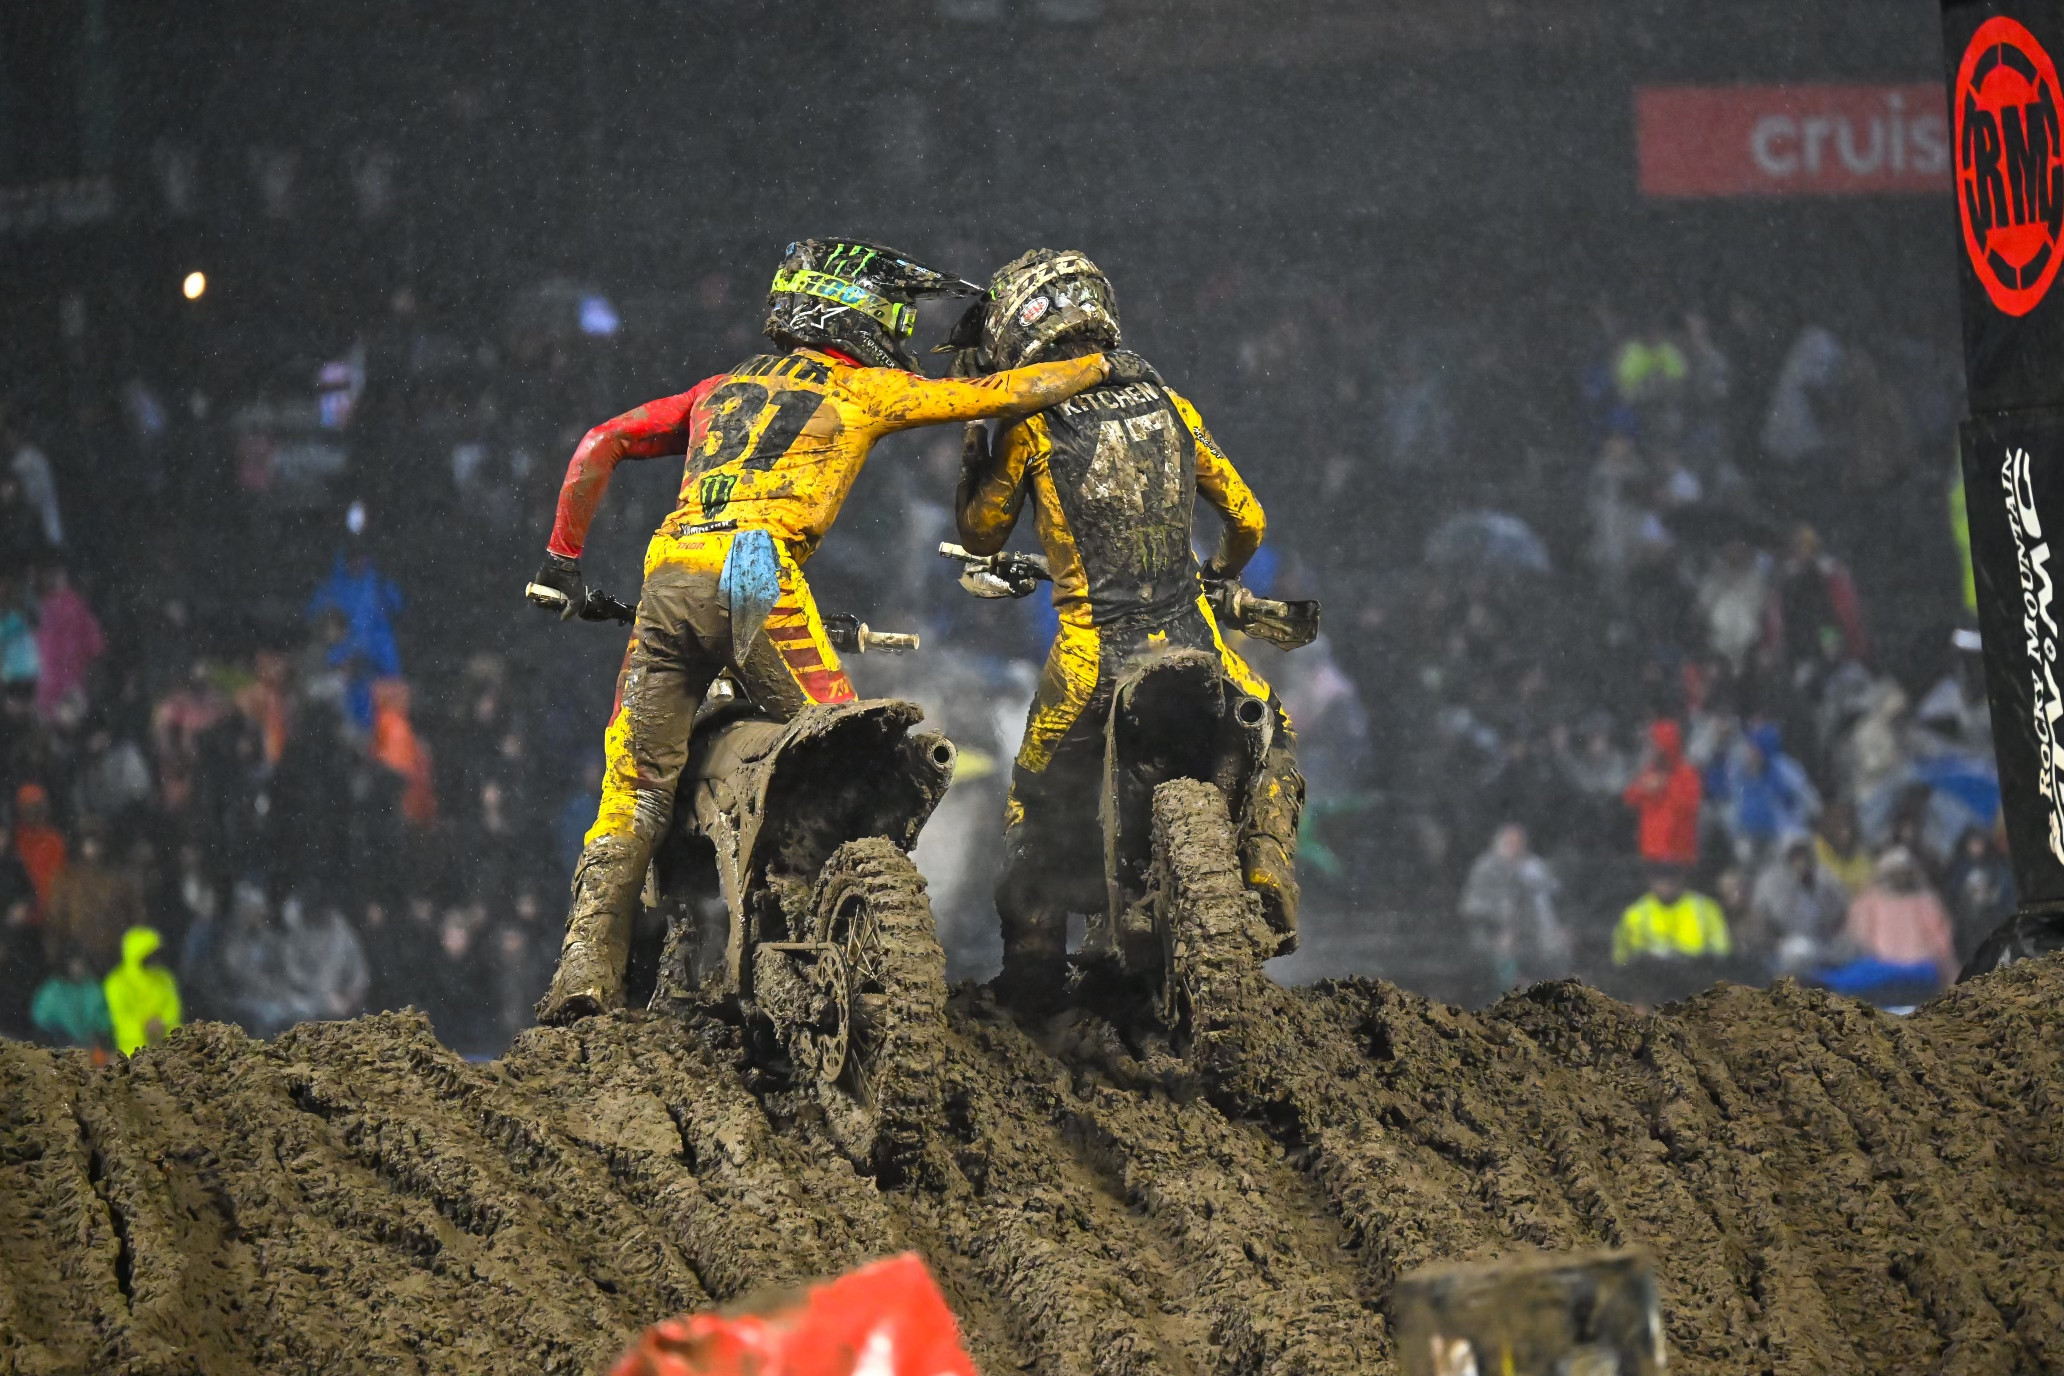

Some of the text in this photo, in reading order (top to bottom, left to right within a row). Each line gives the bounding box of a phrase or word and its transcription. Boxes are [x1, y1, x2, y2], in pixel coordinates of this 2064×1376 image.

[686, 382, 827, 472] 31
[1060, 382, 1160, 416] KITCHEN
[1080, 409, 1182, 516] 47
[677, 541, 706, 550] THOR
[2001, 447, 2053, 803] ROCKY MOUNTAIN
